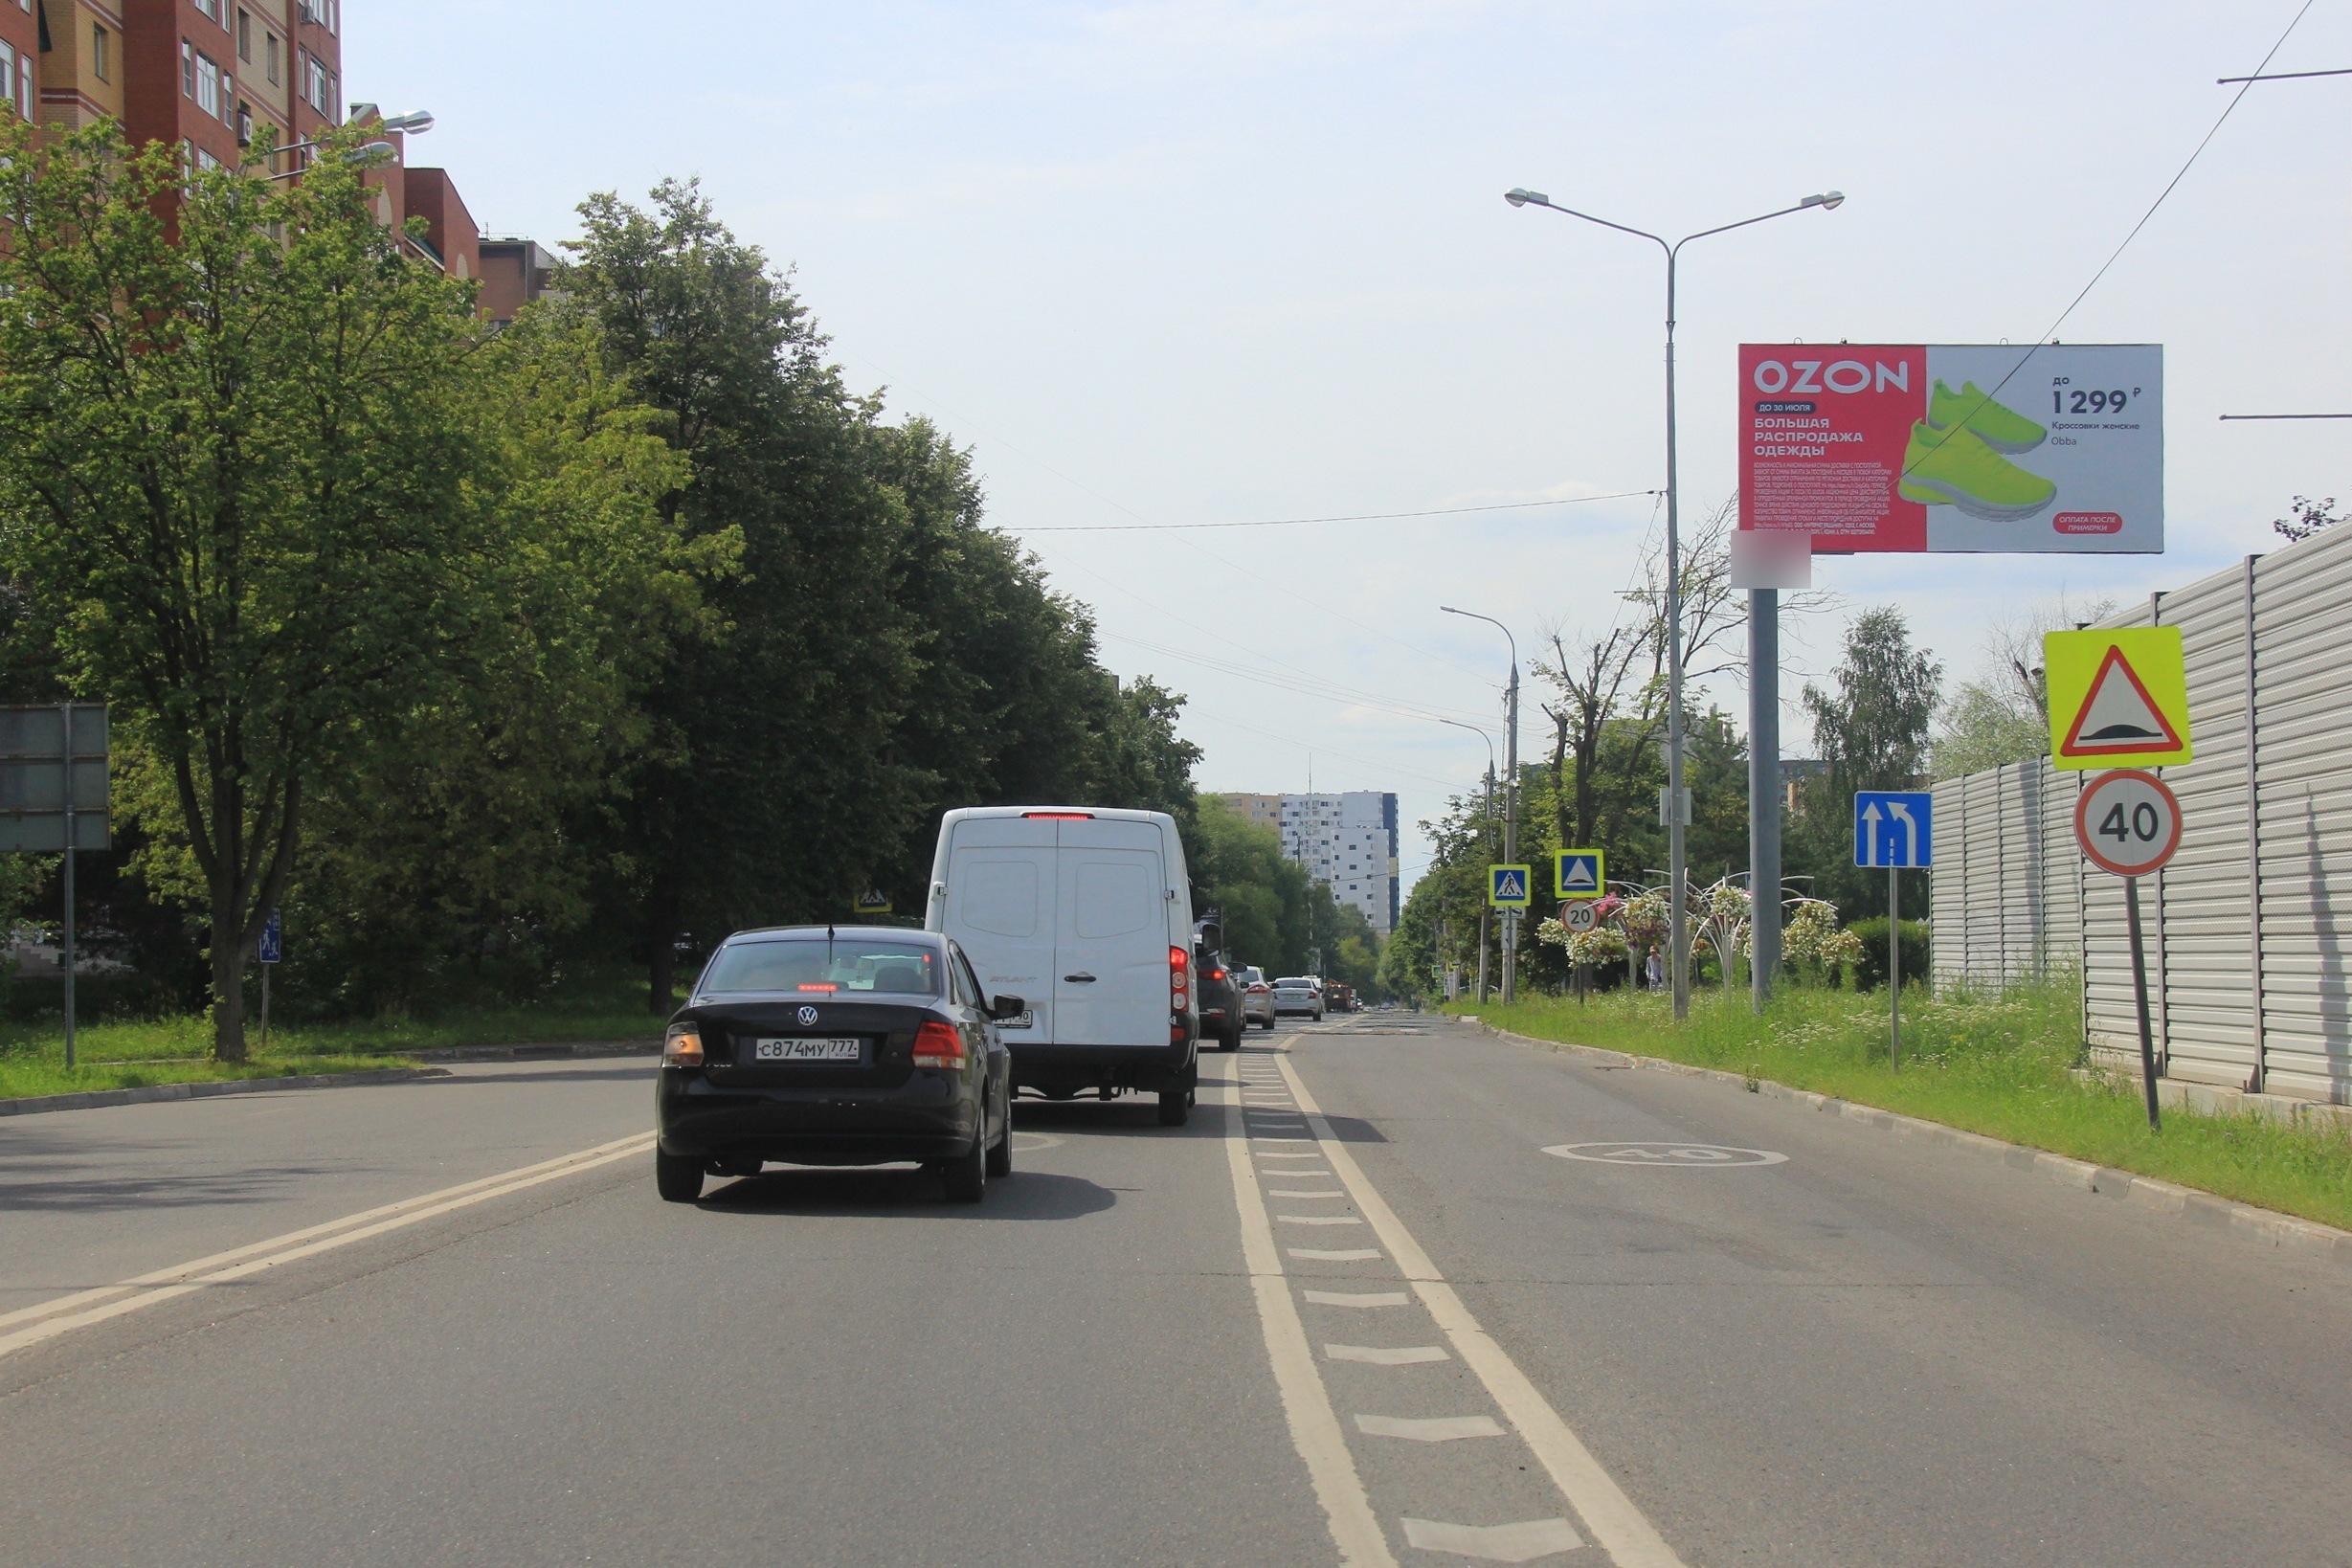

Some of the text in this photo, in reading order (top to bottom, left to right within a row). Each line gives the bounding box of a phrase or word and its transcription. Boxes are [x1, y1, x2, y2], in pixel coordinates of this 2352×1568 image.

[1754, 360, 1908, 393] OZON
[2052, 376, 2070, 386] до
[1758, 404, 1772, 413] ДО
[1754, 418, 1830, 429] БОЛЬШАЯ
[2051, 421, 2099, 431] Кроссовки
[1754, 432, 1864, 443] РАСПРОДАЖА
[2050, 437, 2076, 445] Obba
[1754, 445, 1825, 458] ОДЕЖДЫ
[2098, 802, 2159, 842] 40
[1570, 908, 1590, 924] 20
[1603, 1149, 1732, 1159] 40
